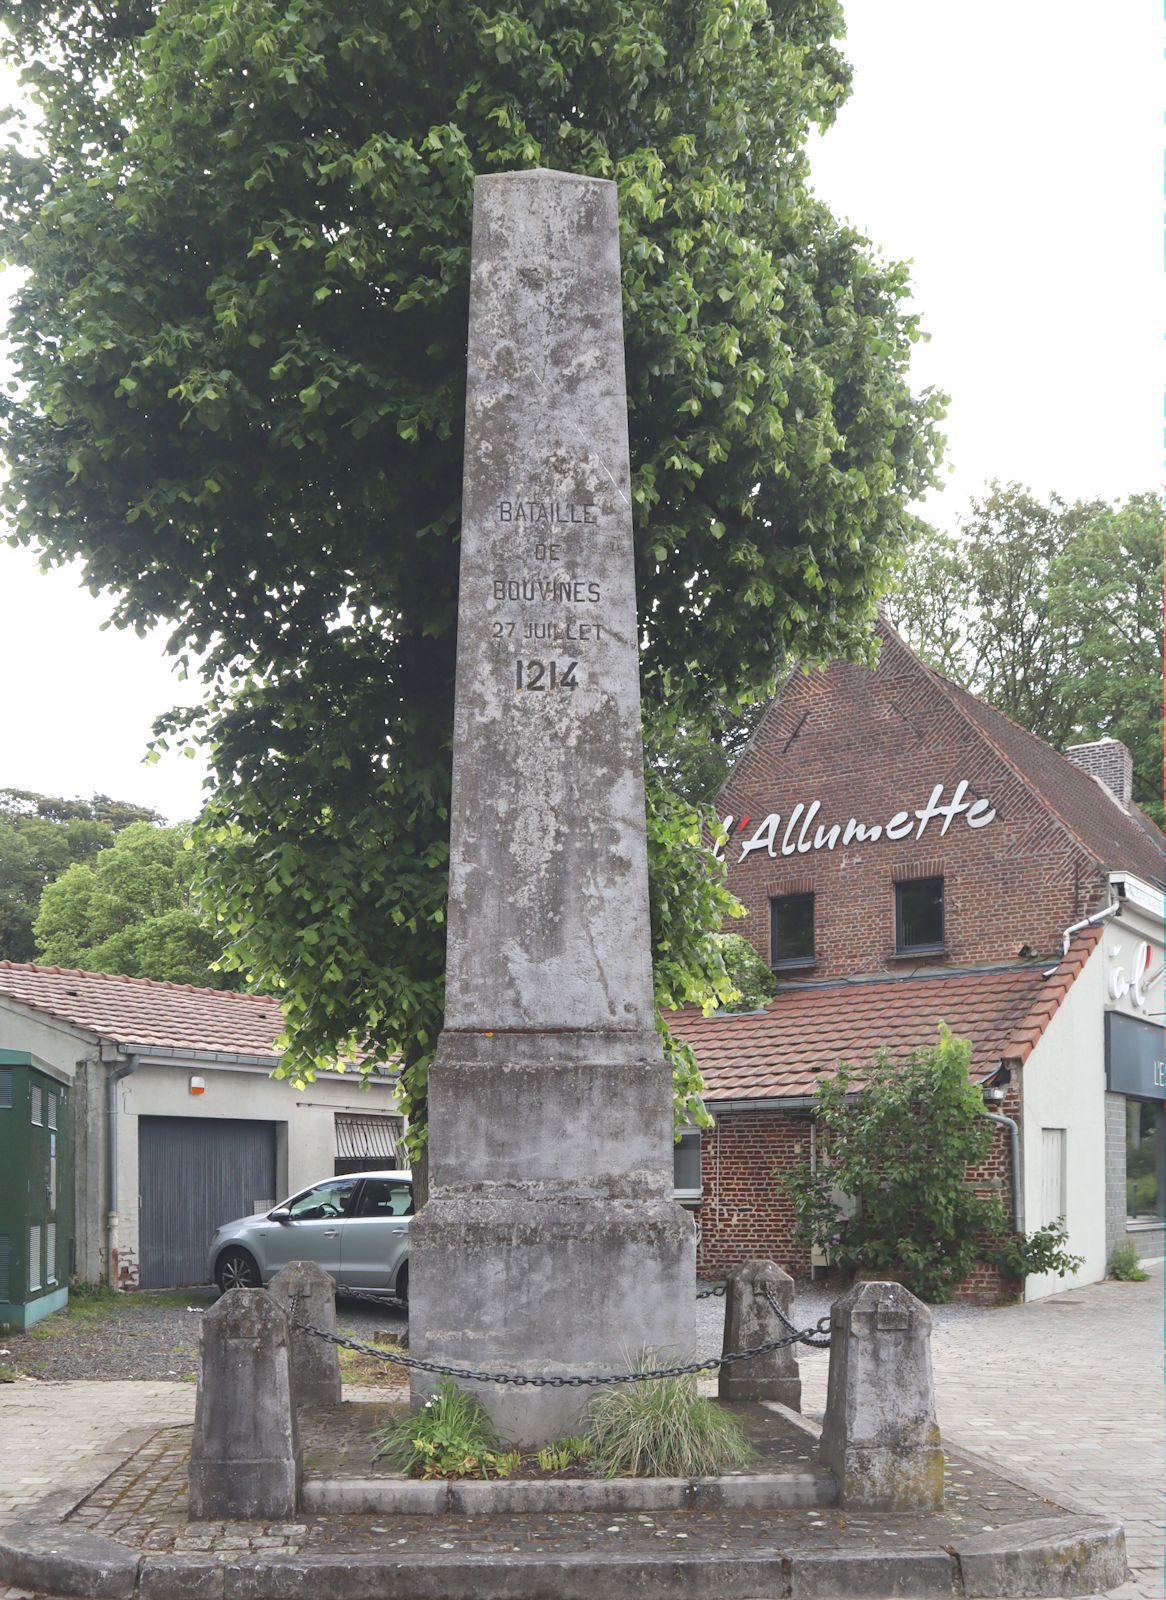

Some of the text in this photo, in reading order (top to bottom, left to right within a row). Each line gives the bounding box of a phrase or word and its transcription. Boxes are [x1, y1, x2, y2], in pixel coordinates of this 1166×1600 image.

[500, 501, 596, 524] BATAILLE
[535, 543, 561, 561] DE
[493, 580, 601, 603] BOUVINES
[492, 622, 603, 641] 27 JUILLET
[516, 660, 579, 691] 1214
